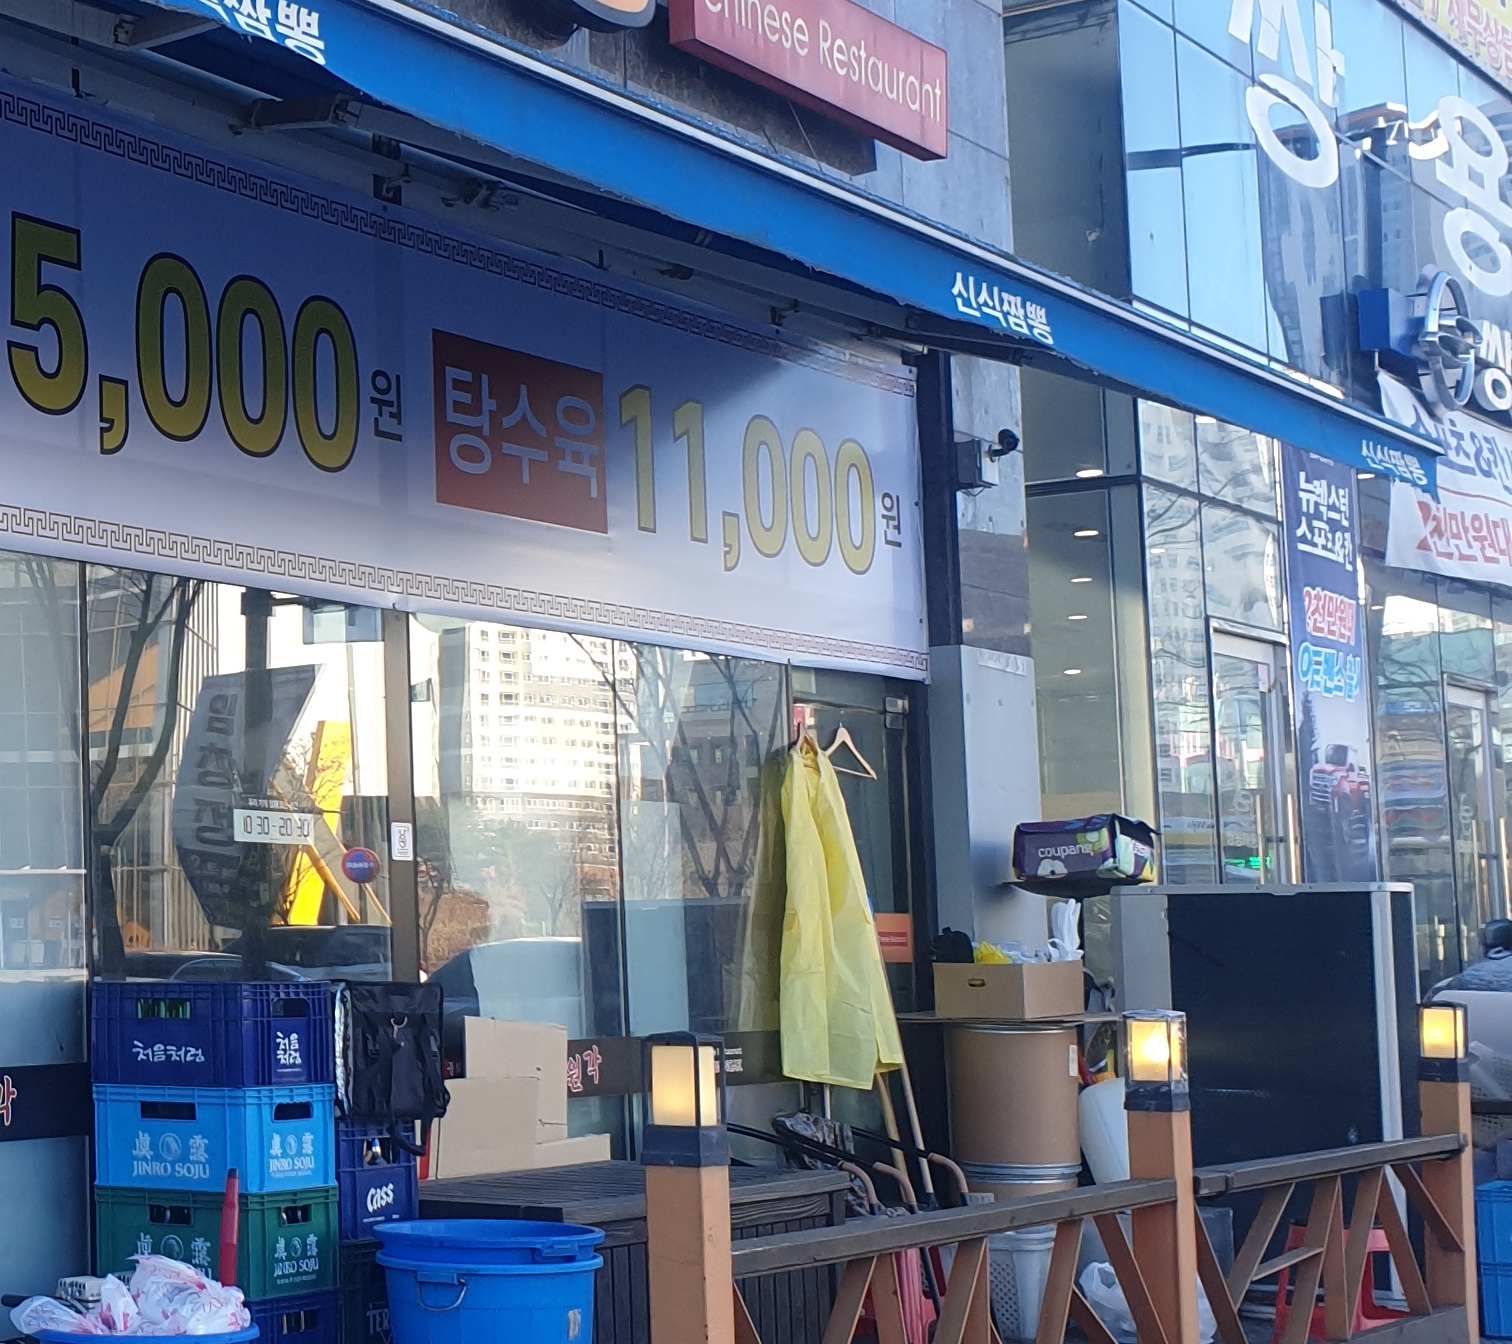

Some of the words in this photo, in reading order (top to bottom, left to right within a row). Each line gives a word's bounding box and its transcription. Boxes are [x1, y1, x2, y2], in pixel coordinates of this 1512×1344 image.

[819, 18, 942, 122] Restaurant
[951, 272, 1055, 345] 신식짬뽕
[444, 365, 598, 498] 탕수육
[132, 1040, 205, 1064] 처음처럼
[132, 1160, 172, 1177] JINRO
[175, 1163, 210, 1179] SOJU
[294, 1156, 315, 1170] SOJU
[299, 1258, 320, 1273] SOJU
